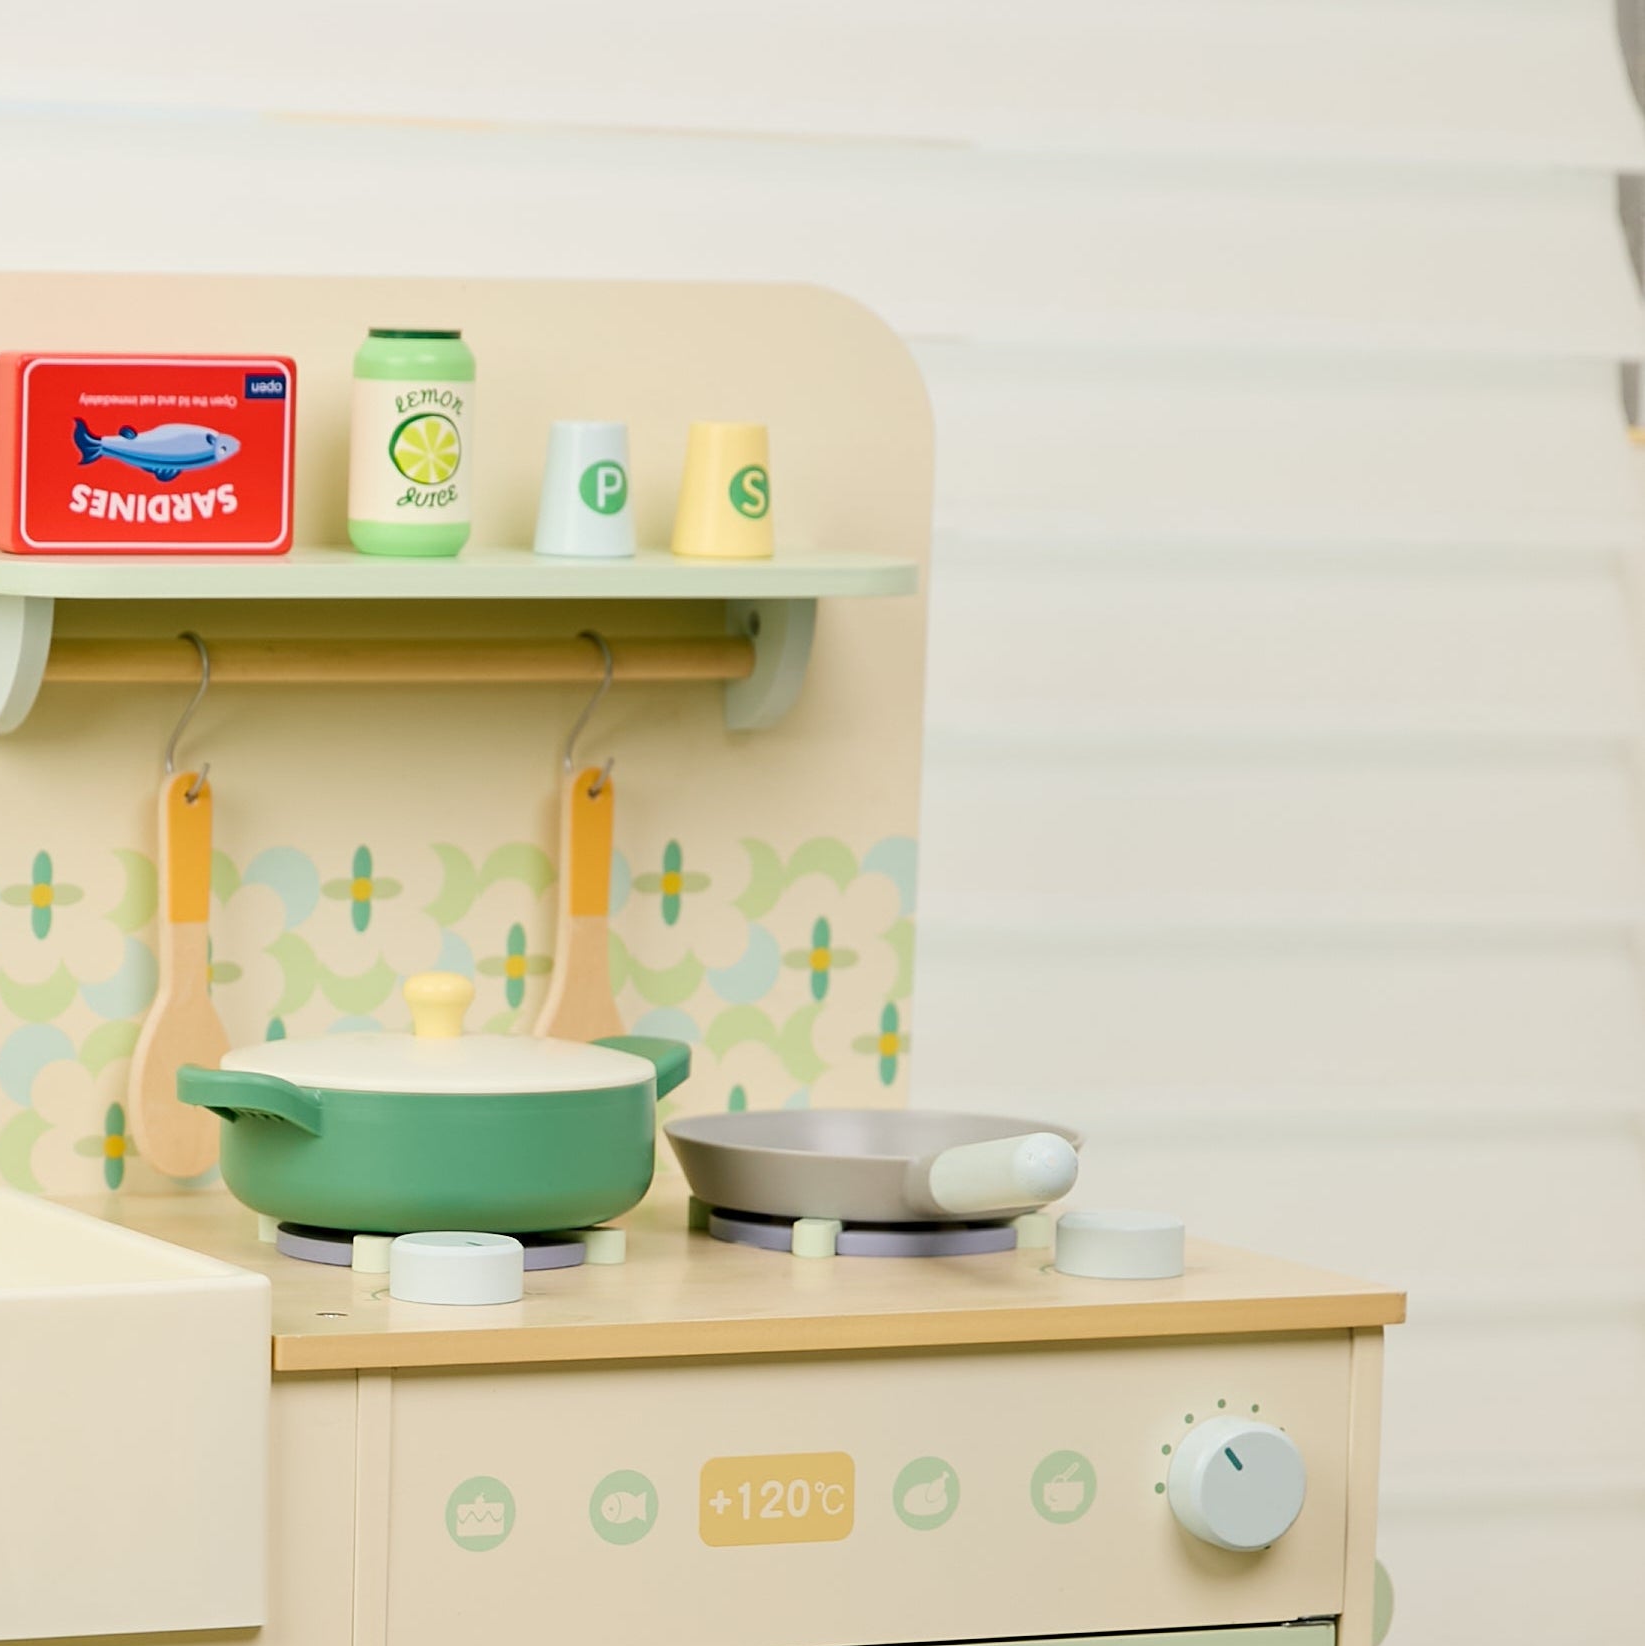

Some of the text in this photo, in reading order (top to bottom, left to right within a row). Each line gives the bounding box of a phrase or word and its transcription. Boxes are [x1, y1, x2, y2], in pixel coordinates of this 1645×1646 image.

[250, 378, 283, 393] open
[68, 484, 238, 523] SARDINES
[597, 466, 623, 508] P
[741, 470, 765, 514] S
